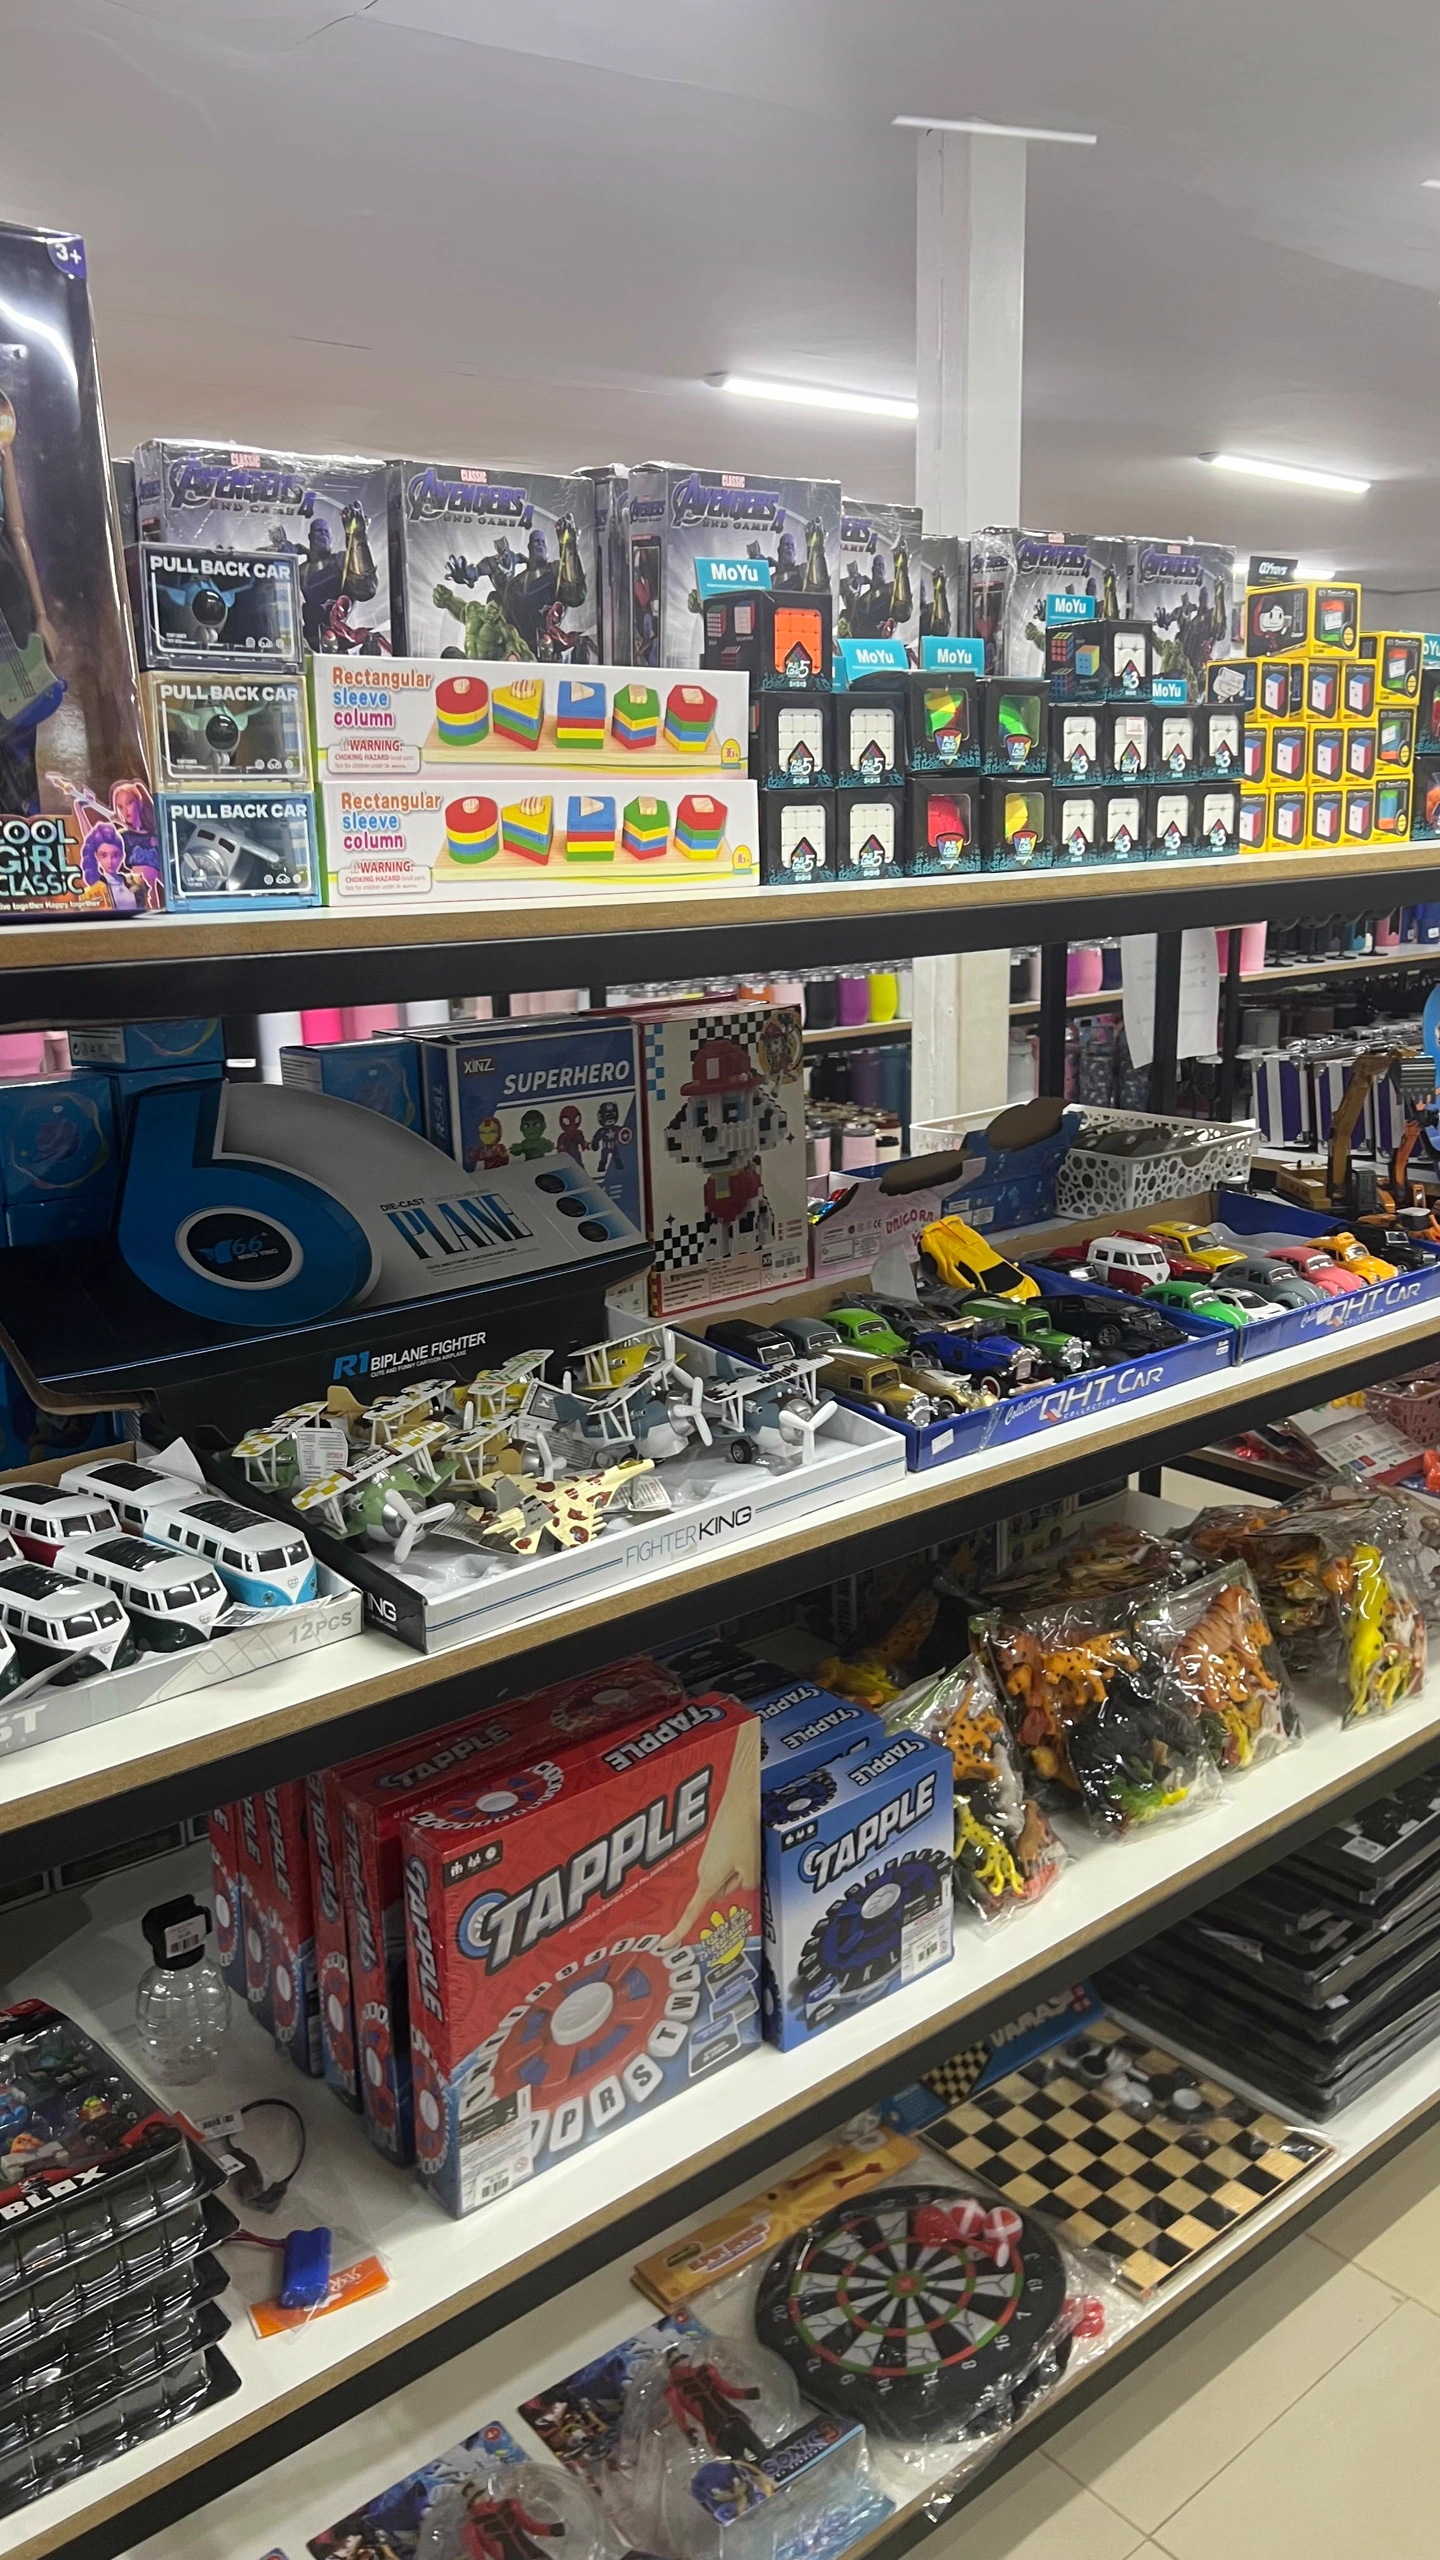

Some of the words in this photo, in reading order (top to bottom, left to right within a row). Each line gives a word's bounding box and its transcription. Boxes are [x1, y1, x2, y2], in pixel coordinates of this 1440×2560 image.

[54, 243, 82, 264] 3+
[461, 468, 487, 483] CLASSIC
[722, 473, 745, 488] CLASSIC
[407, 468, 527, 521] AVENGERS
[518, 505, 534, 530] 4
[670, 473, 780, 528] AVENGERS
[770, 508, 786, 533] 4
[444, 514, 472, 524] END
[478, 517, 516, 527] GAME
[703, 520, 728, 529] END
[734, 522, 769, 531] GAME
[150, 556, 199, 574] PULL
[201, 559, 250, 578] BACK
[253, 563, 290, 580] CAR
[710, 563, 759, 582] MoYu
[1055, 598, 1086, 614] MoYu
[856, 649, 894, 664] MoYu
[937, 648, 972, 665] MoYu
[333, 667, 431, 689] Rectangular
[160, 684, 210, 699] PULL
[211, 686, 260, 701] BACK
[262, 687, 299, 702] CAR
[333, 689, 388, 706] sleeve
[1152, 683, 1182, 698] MoYu
[334, 708, 393, 726] column
[350, 739, 402, 751] WARNING:
[171, 805, 218, 819] PULL
[221, 804, 268, 818] BACK
[270, 804, 307, 818] CAR
[341, 791, 441, 814] Rectangular
[342, 813, 398, 830] sleeve
[0, 820, 78, 845] OOL
[344, 832, 403, 849] column
[361, 861, 413, 873] WARNING:
[345, 875, 374, 883] CHOKING
[12, 901, 43, 911] together
[45, 901, 68, 909] Happy
[503, 1060, 630, 1095] SUPERHERO
[380, 1197, 426, 1212] DIE-CAST
[384, 1193, 534, 1260] PLANE
[232, 1235, 263, 1255] 66
[1385, 1282, 1421, 1305] CAR
[333, 1351, 370, 1380] R1
[371, 1345, 429, 1371] BIPLANE
[431, 1332, 486, 1356] FIGHTER
[370, 1370, 385, 1378] CUTE
[416, 1357, 441, 1367] CARTOON
[1039, 1374, 1115, 1422] QHT
[1118, 1367, 1164, 1394] CAR
[1063, 1397, 1116, 1419] COLLECTION
[760, 1686, 814, 1720] TAPPL
[783, 1708, 853, 1749] TAPPLE
[605, 1704, 712, 1772] TAPPLE
[394, 1724, 512, 1787] TAPPLE
[849, 1740, 919, 1785] TAPPLE
[812, 1773, 937, 1893] TAPPLE
[484, 1767, 713, 1974] TAPPLE
[406, 1860, 444, 2023] TAPPLE
[1027, 2278, 1043, 2292] 19
[772, 2304, 787, 2322] 20
[1016, 2312, 1032, 2320] 7
[784, 2335, 799, 2346] 5
[994, 2334, 1010, 2351] 16
[806, 2358, 821, 2373] 12
[961, 2359, 977, 2370] 8
[840, 2373, 855, 2386] 9
